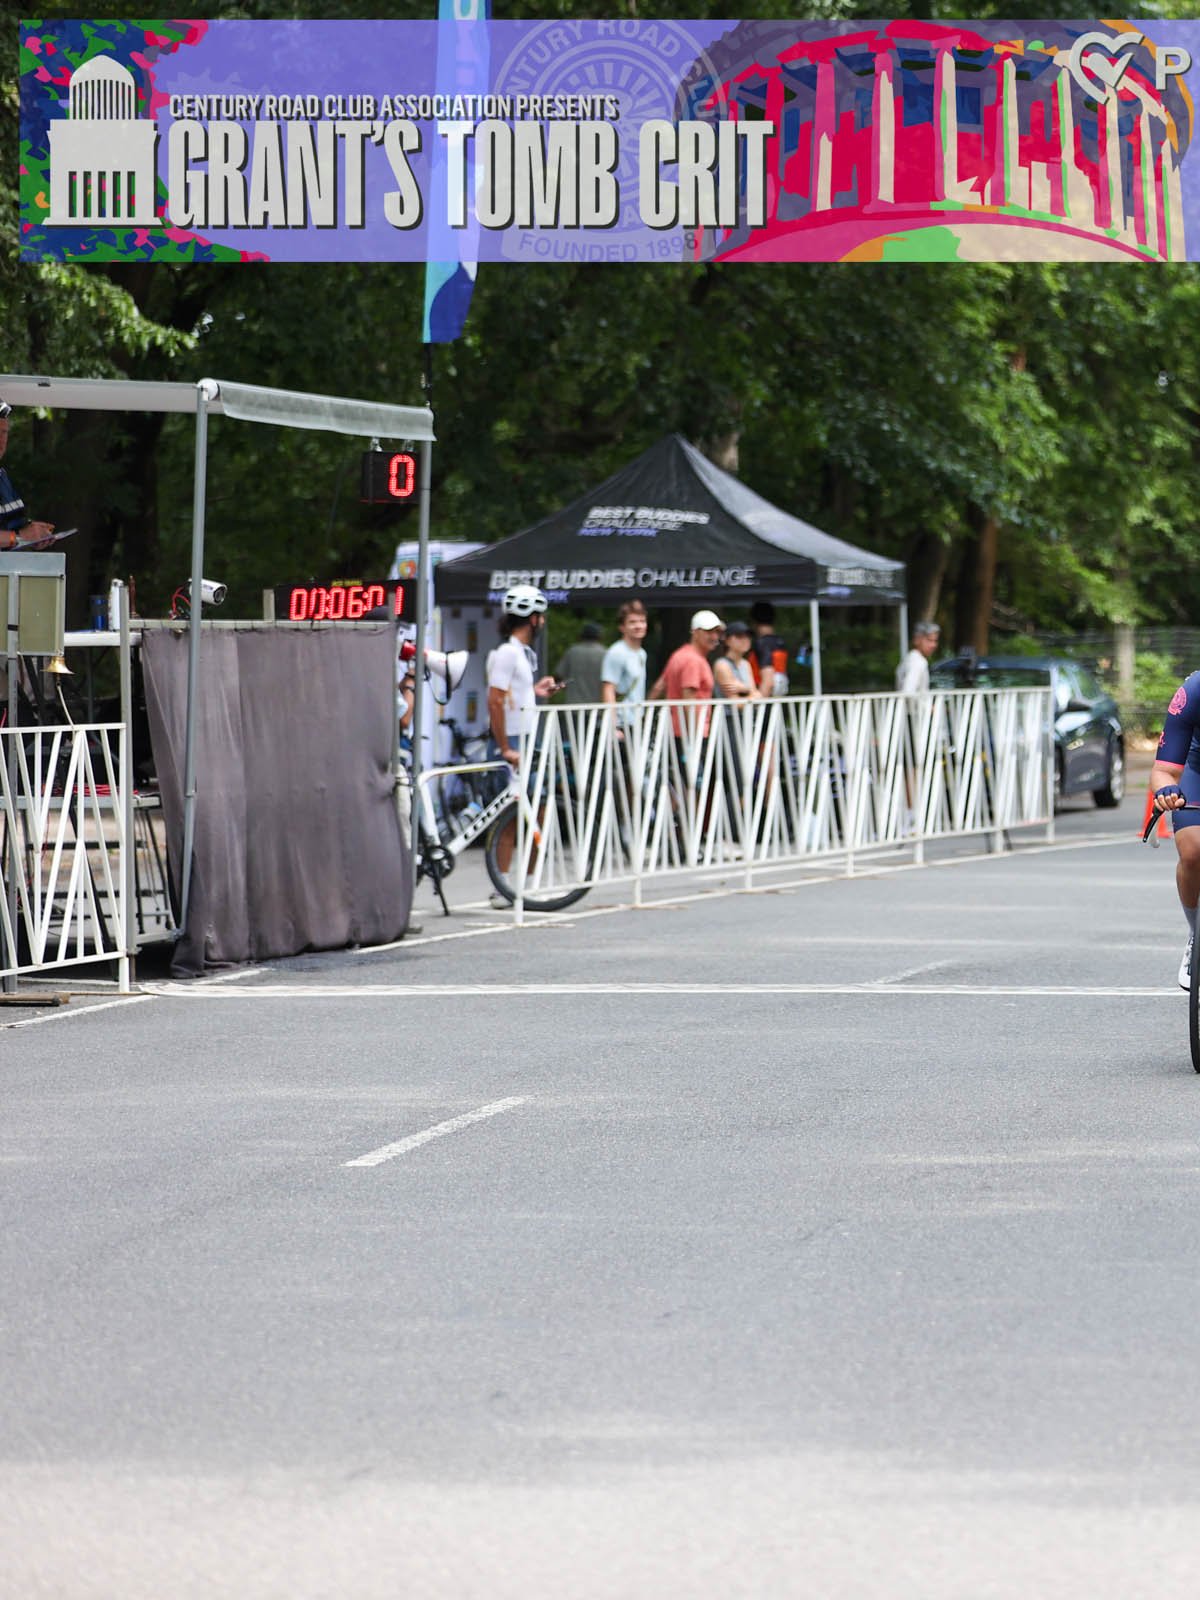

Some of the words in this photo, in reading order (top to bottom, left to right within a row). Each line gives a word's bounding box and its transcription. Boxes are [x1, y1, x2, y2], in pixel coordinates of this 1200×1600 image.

[389, 454, 415, 497] 0
[489, 569, 546, 590] BEST
[545, 568, 636, 590] BUDDIES
[637, 564, 756, 588] CHALLENGE
